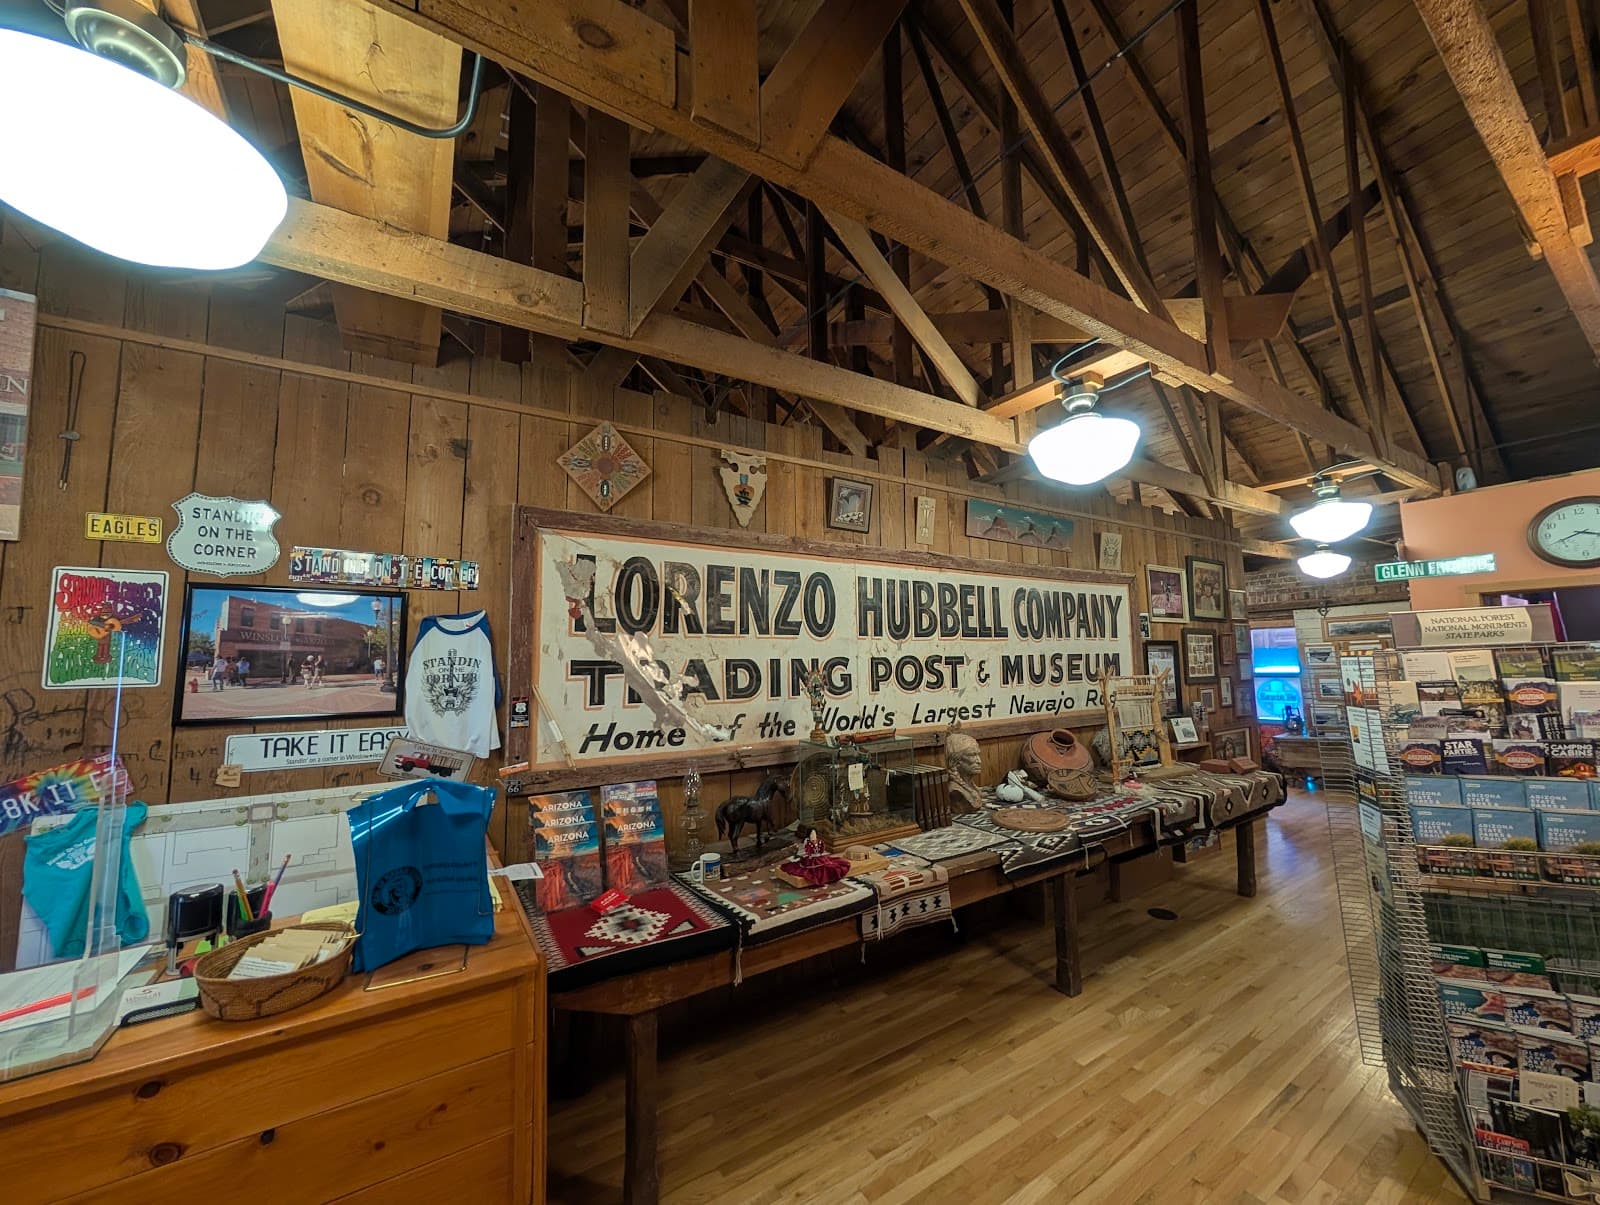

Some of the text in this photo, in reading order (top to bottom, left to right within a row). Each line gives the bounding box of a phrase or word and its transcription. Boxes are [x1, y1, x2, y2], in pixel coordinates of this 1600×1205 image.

[91, 518, 157, 536] EAGLES
[198, 525, 255, 541] ON THE
[193, 543, 257, 559] CORNER
[1381, 562, 1425, 579] GLENN
[574, 553, 1123, 641] LORENZO HUBBELL COMPANY
[1430, 613, 1515, 624] NATIONAL FOREST
[1424, 621, 1528, 632] NATIONAL MONUMENTS
[1445, 630, 1505, 640] STATE PARKS
[423, 656, 482, 670] STANDIN
[426, 672, 478, 684] CORNER
[870, 654, 966, 692] POST
[977, 660, 990, 684] &
[1001, 653, 1121, 685] MUSEUM
[579, 721, 686, 755] Home
[758, 711, 795, 739] the
[911, 698, 997, 726] Largest
[1009, 690, 1075, 715] Navajo
[260, 735, 319, 758] TAKE
[330, 734, 349, 754] IT
[1444, 741, 1473, 749] STAR
[1442, 748, 1478, 756] PARTIES
[1551, 749, 1594, 757] CABINS
[507, 783, 520, 793] 66
[0, 791, 40, 822] 8K
[48, 779, 76, 806] IT
[541, 801, 583, 813] ARIZONA
[544, 815, 586, 828] ARIZONA
[617, 820, 656, 832] ARIZONA
[547, 831, 590, 844] ARIZONA
